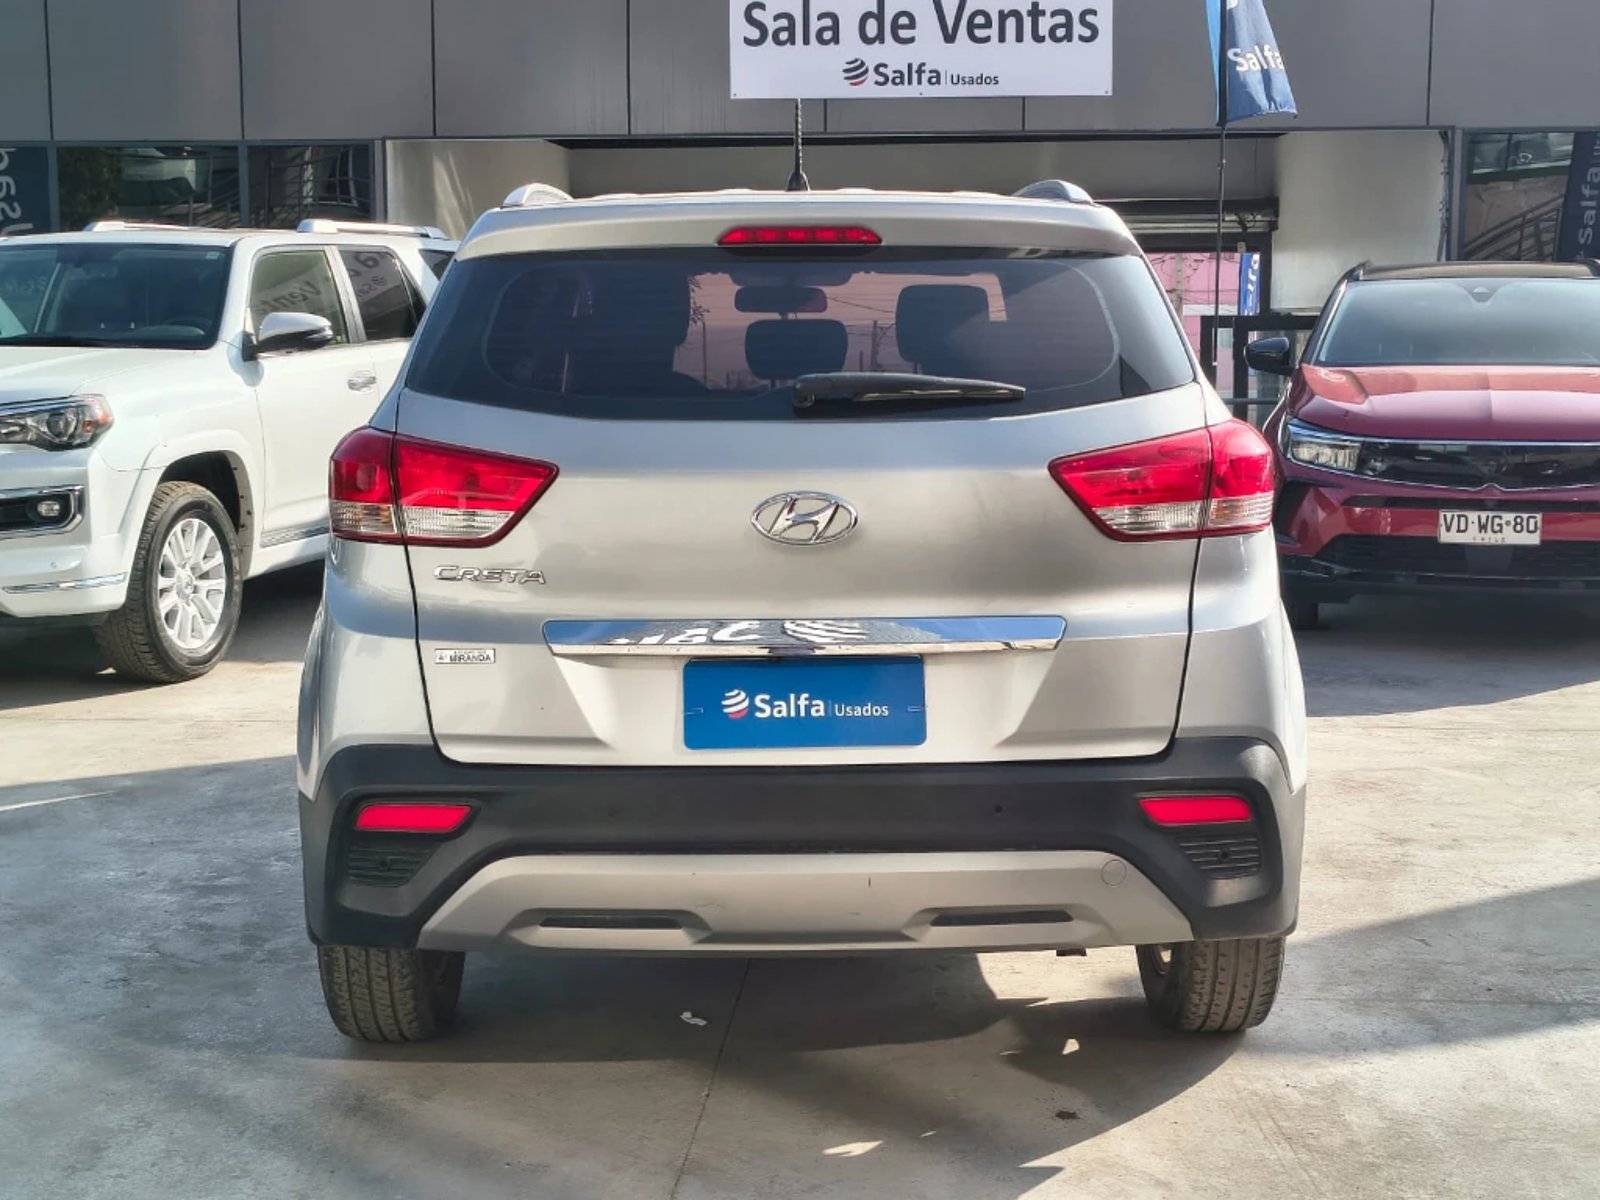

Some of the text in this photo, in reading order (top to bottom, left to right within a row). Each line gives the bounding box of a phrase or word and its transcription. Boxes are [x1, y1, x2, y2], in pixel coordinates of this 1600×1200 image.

[743, 0, 1099, 47] Sala de Ventas
[1227, 44, 1284, 71] Salfa
[873, 62, 999, 86] Salfa Usados
[433, 565, 546, 585] CRETA
[754, 693, 889, 718] Salfa Usados
